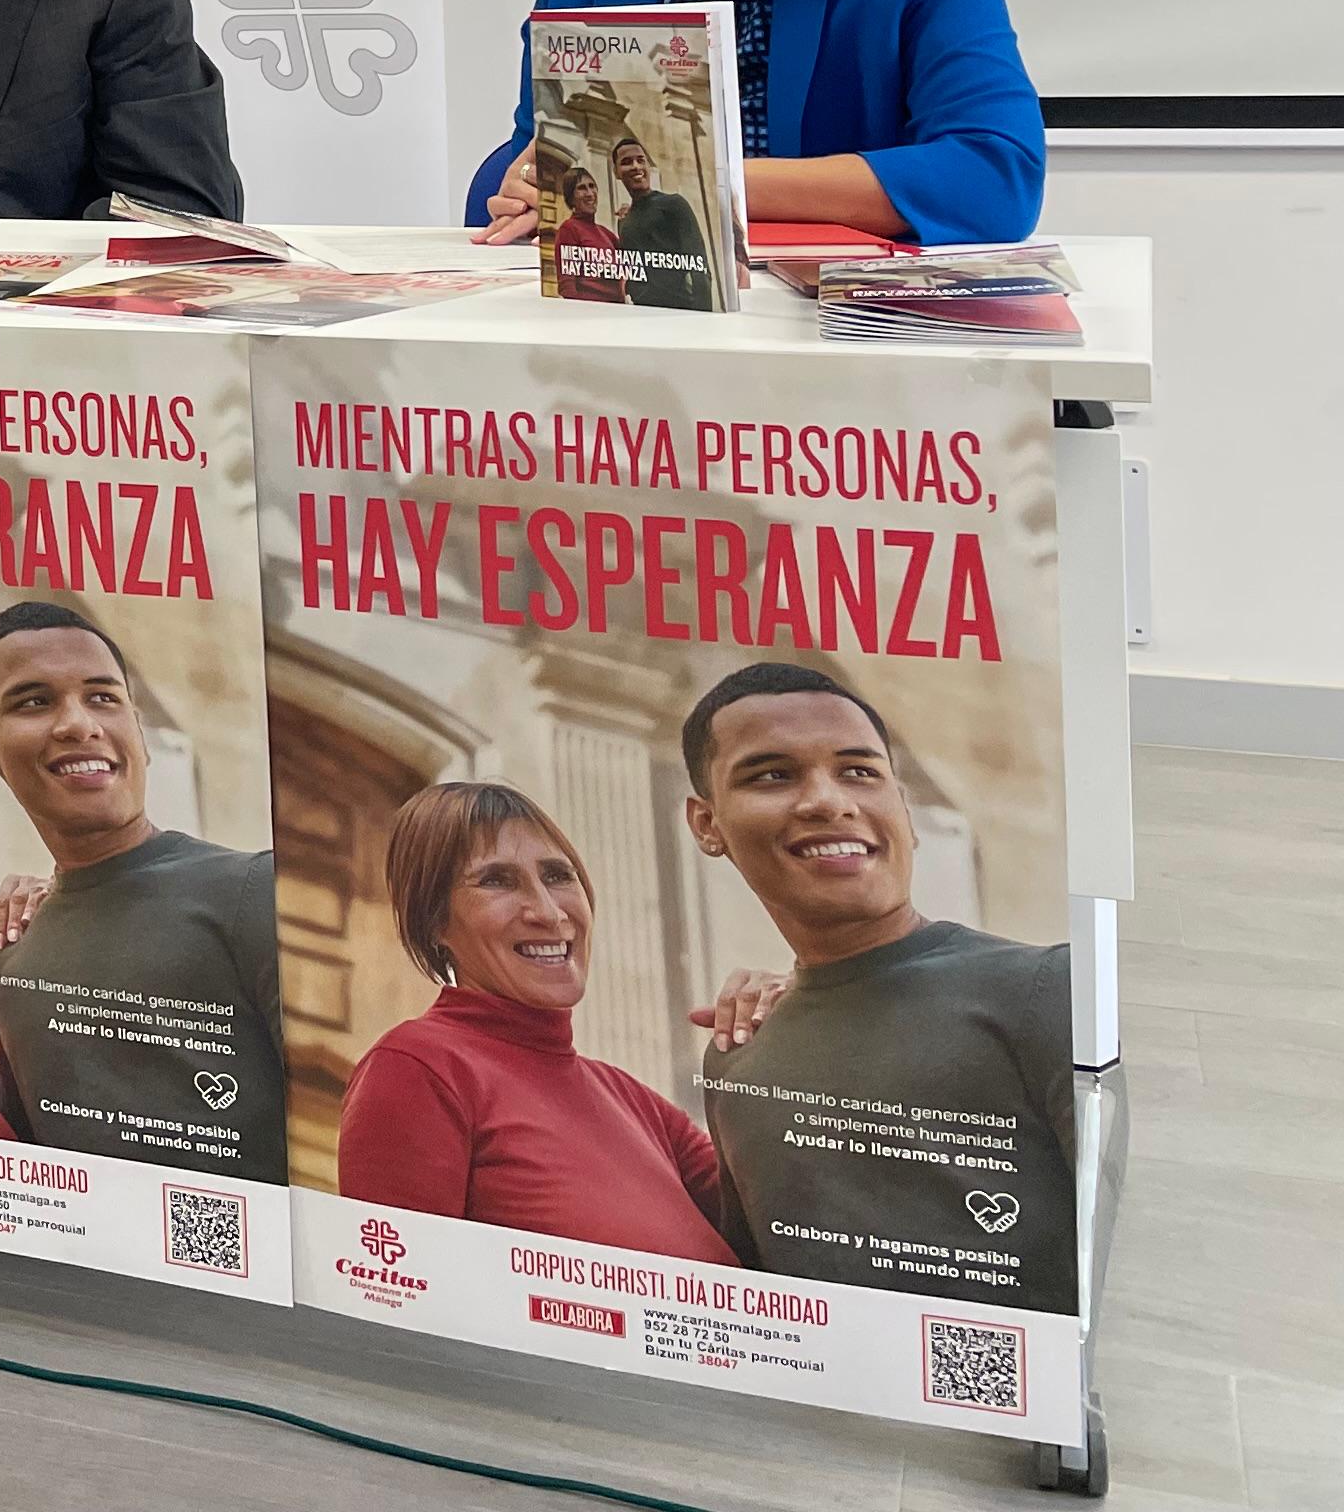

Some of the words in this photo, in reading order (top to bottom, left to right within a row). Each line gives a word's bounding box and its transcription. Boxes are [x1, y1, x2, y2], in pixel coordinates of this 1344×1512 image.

[547, 36, 642, 54] MEMORIA
[548, 52, 602, 73] 2024
[560, 244, 613, 264] MIENTRAS
[615, 250, 643, 266] HAYA
[645, 253, 708, 274] PERSONAS,
[561, 261, 582, 275] HAY
[583, 262, 647, 282] ESPERANZA
[294, 400, 538, 484] MIENTRAS
[553, 413, 681, 491] HAYA
[696, 421, 999, 514] PERSONAS,
[297, 492, 451, 620] HAY
[478, 504, 1003, 664] ESPERANZA
[692, 1074, 769, 1098] Podemos
[773, 1085, 837, 1108] llamarlo
[840, 1095, 908, 1118] caridad,
[910, 1105, 1017, 1130] generosidad
[40, 1099, 104, 1120] Colabora
[106, 1111, 115, 1124] y
[118, 1112, 183, 1132] hagamos
[187, 1121, 241, 1141] posible
[794, 1112, 805, 1124] o
[808, 1113, 916, 1140] simplemente
[919, 1128, 1018, 1152] humanidad.
[121, 1130, 139, 1142] un
[142, 1133, 192, 1151] mundo
[196, 1140, 242, 1159] mejor.
[783, 1129, 844, 1151] Ayudar
[849, 1138, 866, 1154] lo
[871, 1141, 950, 1165] llevamos
[955, 1154, 1019, 1173] dentro.
[20, 1160, 89, 1194] CARIDAD
[770, 1220, 850, 1245] Colabora
[854, 1234, 864, 1249] y
[869, 1235, 950, 1259] hagamos
[955, 1247, 1021, 1269] posible
[336, 1258, 428, 1291] Cáritas
[511, 1247, 585, 1284] CORPUS
[591, 1262, 671, 1300] CHRISTI.
[676, 1273, 708, 1308] DÍA
[713, 1282, 738, 1313] DE
[743, 1287, 829, 1326] CARIDAD
[871, 1256, 894, 1270] un
[899, 1260, 960, 1278] mundo
[964, 1268, 1021, 1288] mejor.
[349, 1278, 402, 1298] Diocesana
[404, 1291, 416, 1300] de
[364, 1292, 402, 1308] Málaga
[541, 1300, 614, 1332] COLABORA
[644, 1308, 801, 1343] www.caritasmalaga.es
[644, 1320, 668, 1332] 952
[673, 1325, 689, 1336] 28
[693, 1330, 709, 1340] 72
[714, 1333, 730, 1343] 50
[645, 1335, 653, 1343] o
[658, 1337, 674, 1346] en
[679, 1339, 692, 1350] tu
[697, 1341, 747, 1359] Cáritas
[751, 1352, 825, 1372] parroquial
[698, 1354, 738, 1369] 38047
